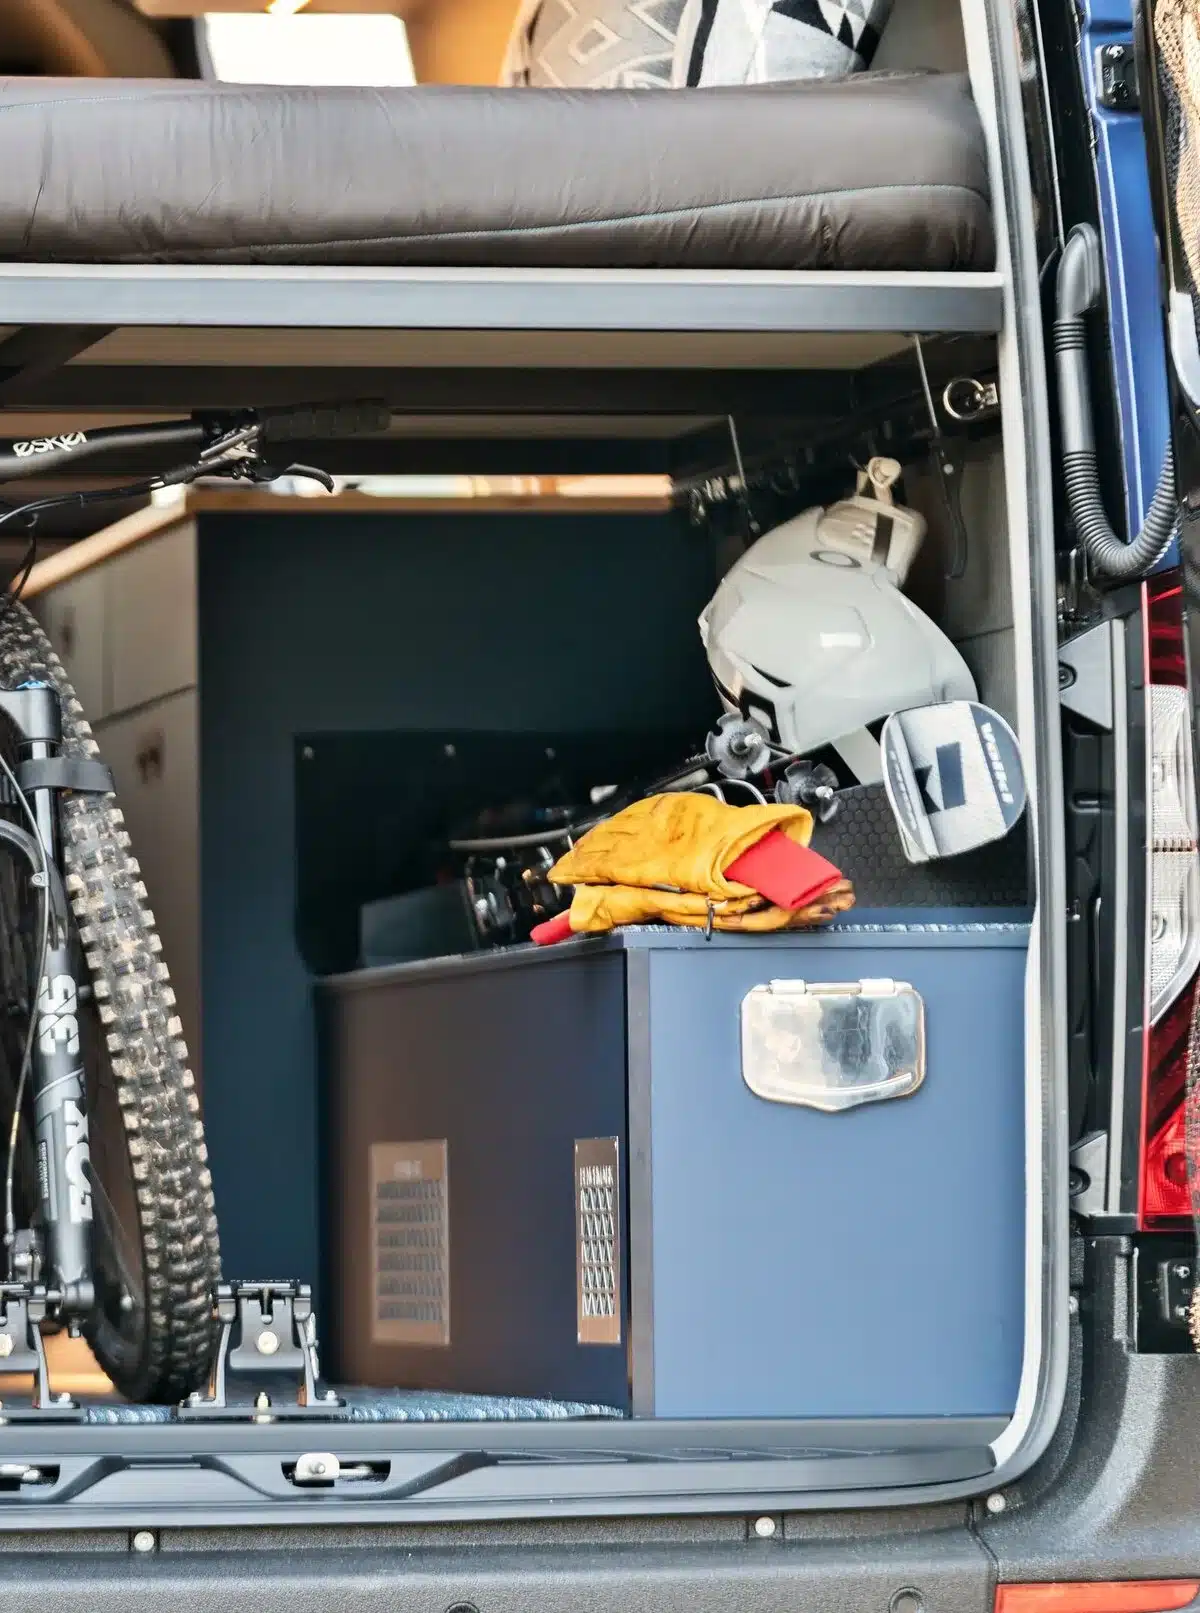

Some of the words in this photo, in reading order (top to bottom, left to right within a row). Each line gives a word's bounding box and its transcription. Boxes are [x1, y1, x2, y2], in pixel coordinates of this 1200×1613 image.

[37, 974, 80, 1055] 36
[40, 1141, 49, 1199] PERFORMANCE
[63, 1100, 93, 1224] FOX
